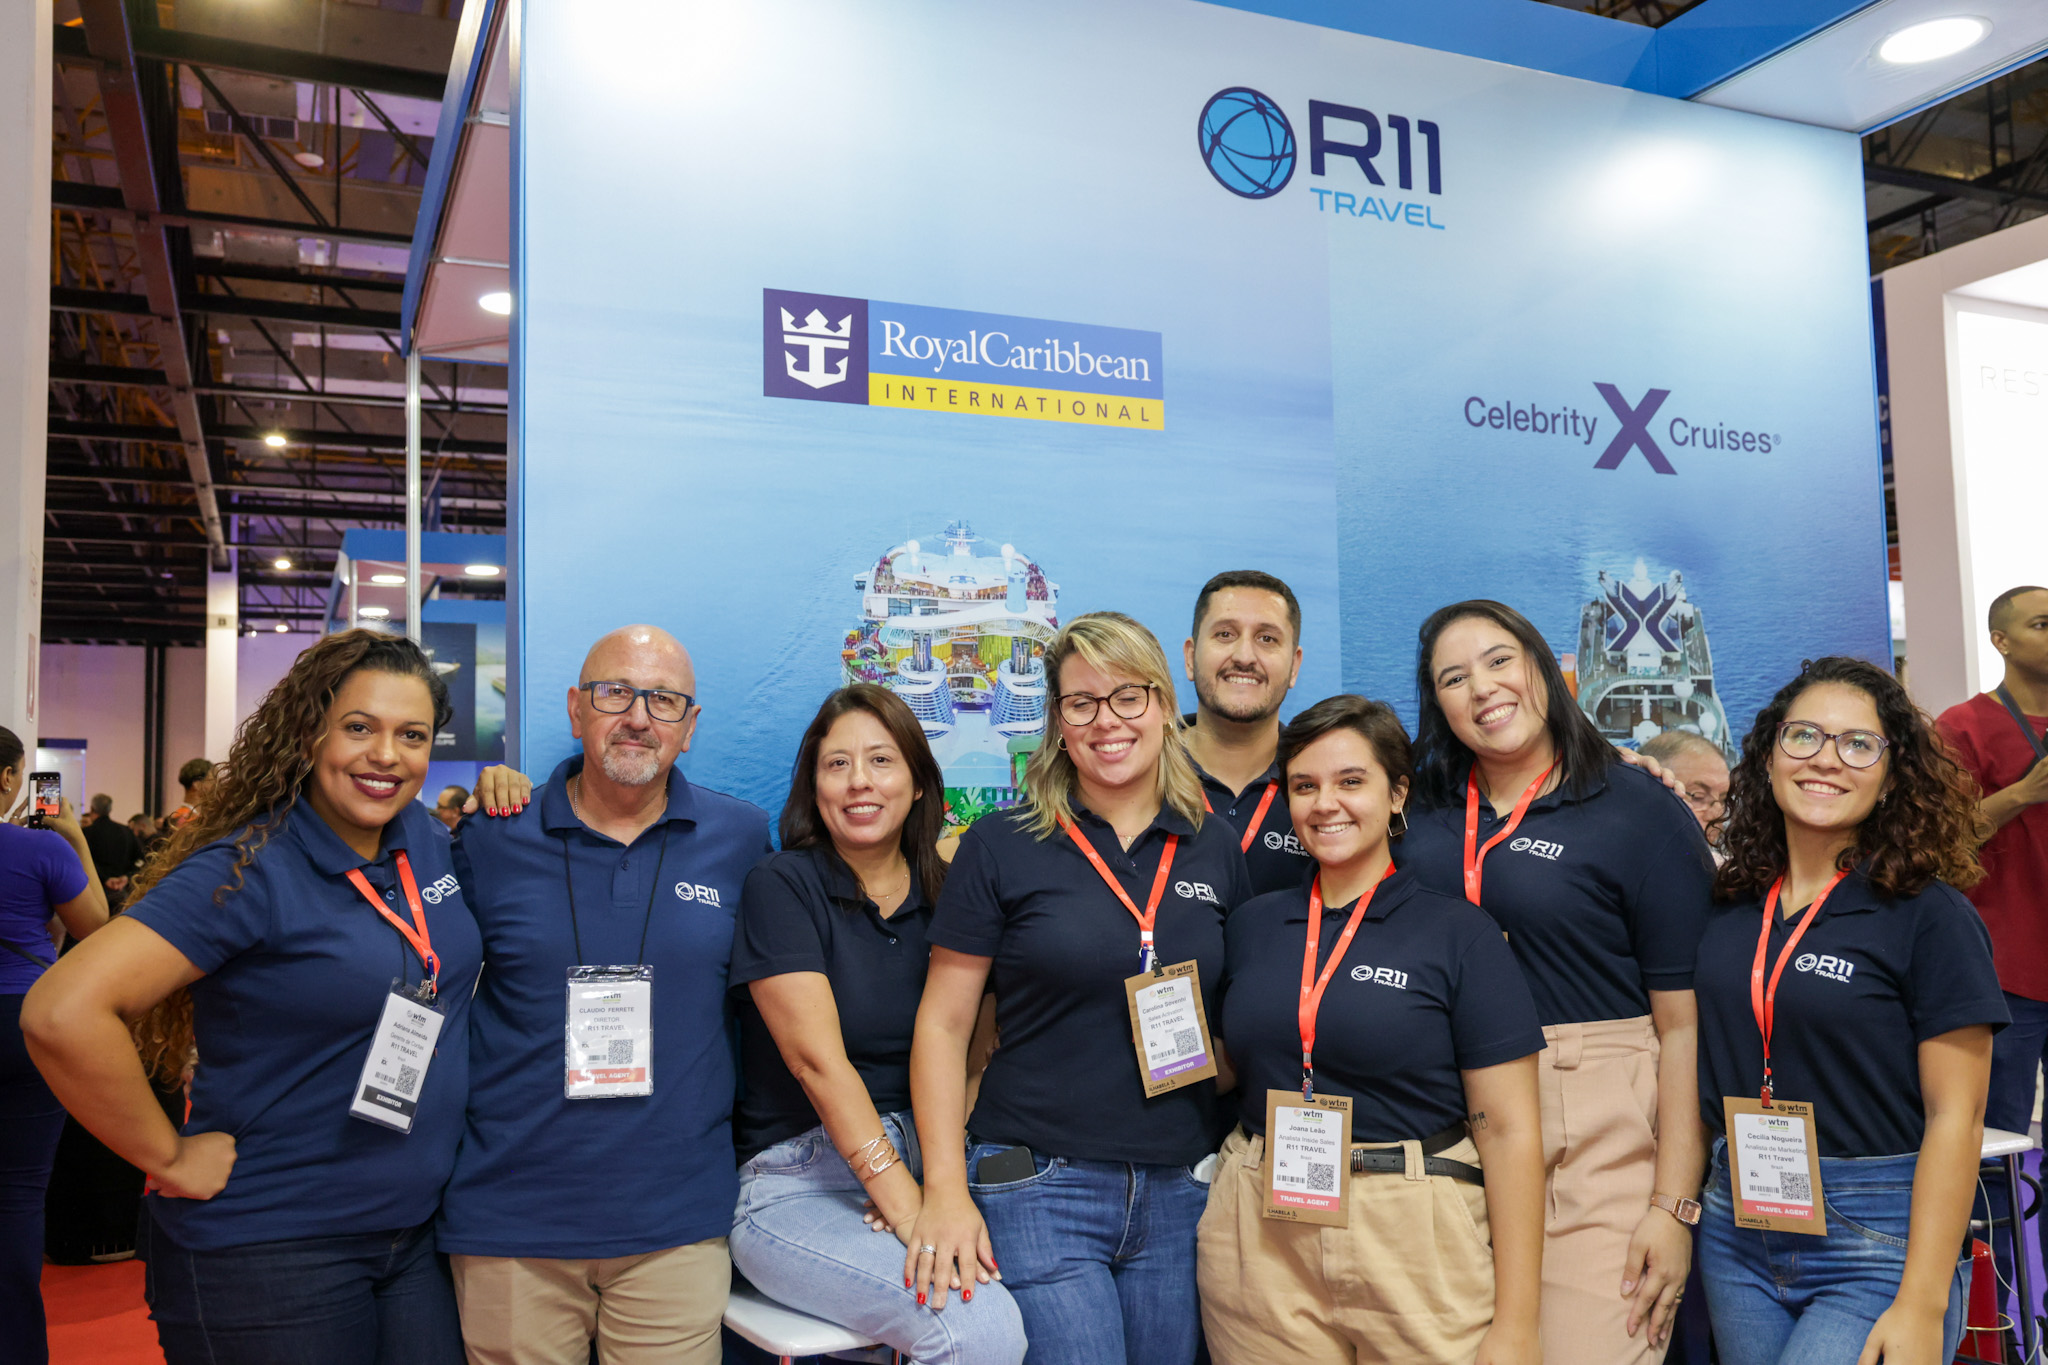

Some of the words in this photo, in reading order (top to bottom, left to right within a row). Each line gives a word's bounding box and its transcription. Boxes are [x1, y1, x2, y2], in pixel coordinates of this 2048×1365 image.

[1308, 98, 1443, 196] R11
[1309, 187, 1446, 231] TRAVEL
[1980, 364, 2048, 398] RES
[885, 383, 1150, 423] INTERNATIONAL
[1464, 396, 1598, 446] Celebrity
[1529, 839, 1565, 858] R11
[1528, 849, 1557, 861] TRAVEL
[694, 884, 720, 903] R11
[1176, 964, 1194, 973] wtm
[1817, 954, 1854, 977] R11
[1373, 967, 1409, 987] R11
[1814, 969, 1850, 984] TRAVEL
[1156, 985, 1175, 995] wtm
[1373, 978, 1407, 990] TRAVEL
[413, 1012, 427, 1024] wtm
[1150, 1022, 1162, 1030] R11
[1162, 1015, 1184, 1026] TRAVEL
[1164, 1061, 1195, 1076] EXHIBITOR
[1328, 1099, 1348, 1108] wtm
[1787, 1104, 1808, 1112] wtm
[1303, 1109, 1323, 1119] wtm
[1289, 1124, 1308, 1132] Joana
[1767, 1118, 1790, 1127] wtm
[1278, 1134, 1301, 1142] Analista
[1301, 1136, 1319, 1144] Inside
[1771, 1135, 1803, 1144] Nogueira
[1286, 1143, 1299, 1151] R11
[1300, 1145, 1327, 1154] TRAVEL
[1745, 1143, 1768, 1151] Analista
[1777, 1146, 1808, 1155] Marketing
[1773, 1154, 1795, 1163] Travel
[1280, 1195, 1305, 1204] TRAVEL
[1306, 1198, 1330, 1207] AGENT
[1755, 1205, 1783, 1214] TRAVEL
[1784, 1208, 1809, 1217] AGENT
